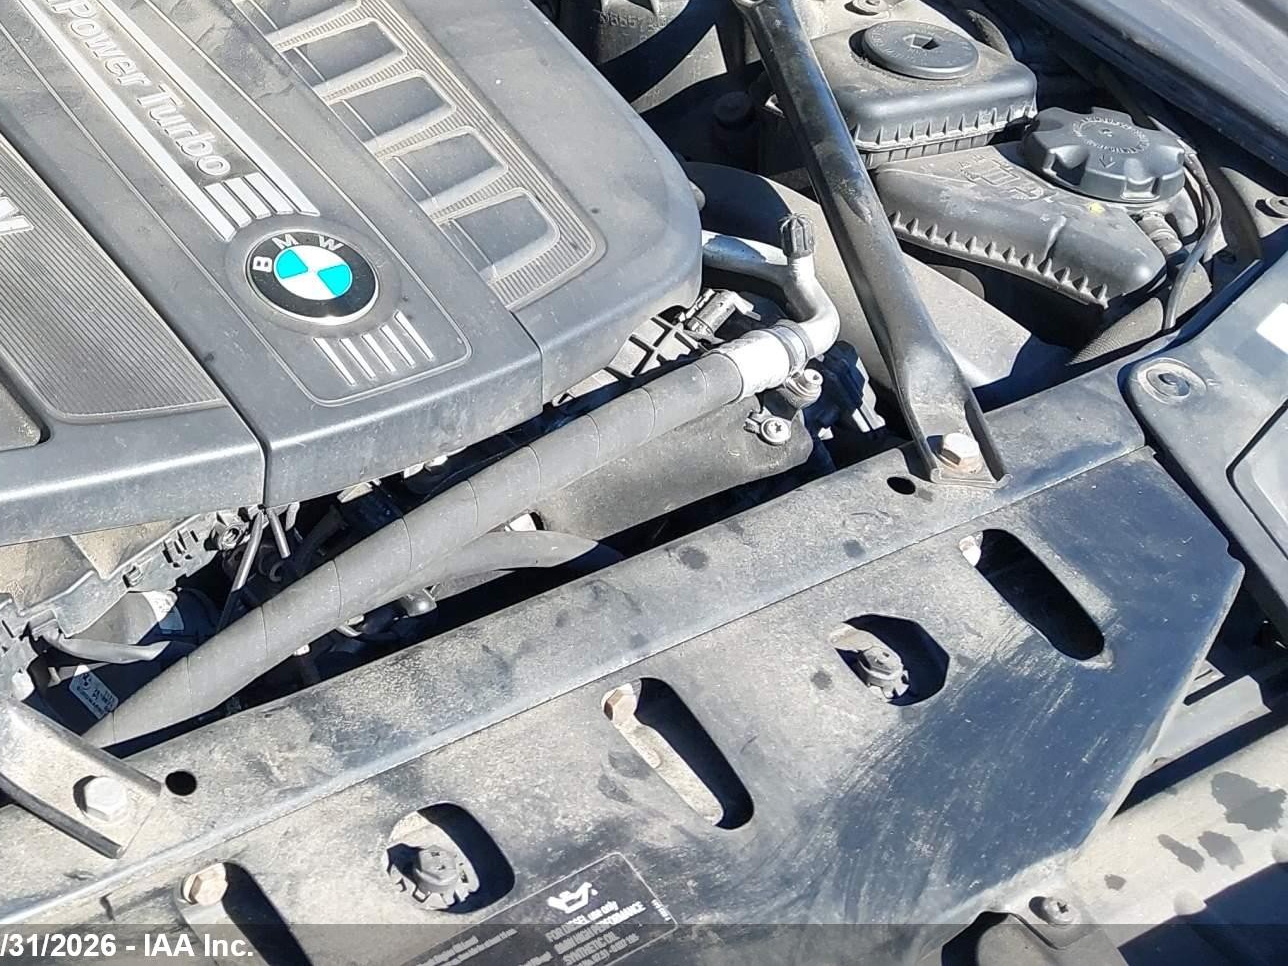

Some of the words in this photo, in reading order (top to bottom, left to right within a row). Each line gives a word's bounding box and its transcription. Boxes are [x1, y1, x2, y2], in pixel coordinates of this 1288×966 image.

[135, 83, 232, 177] Turbo
[252, 233, 345, 273] BMW
[545, 927, 565, 943] FOR
